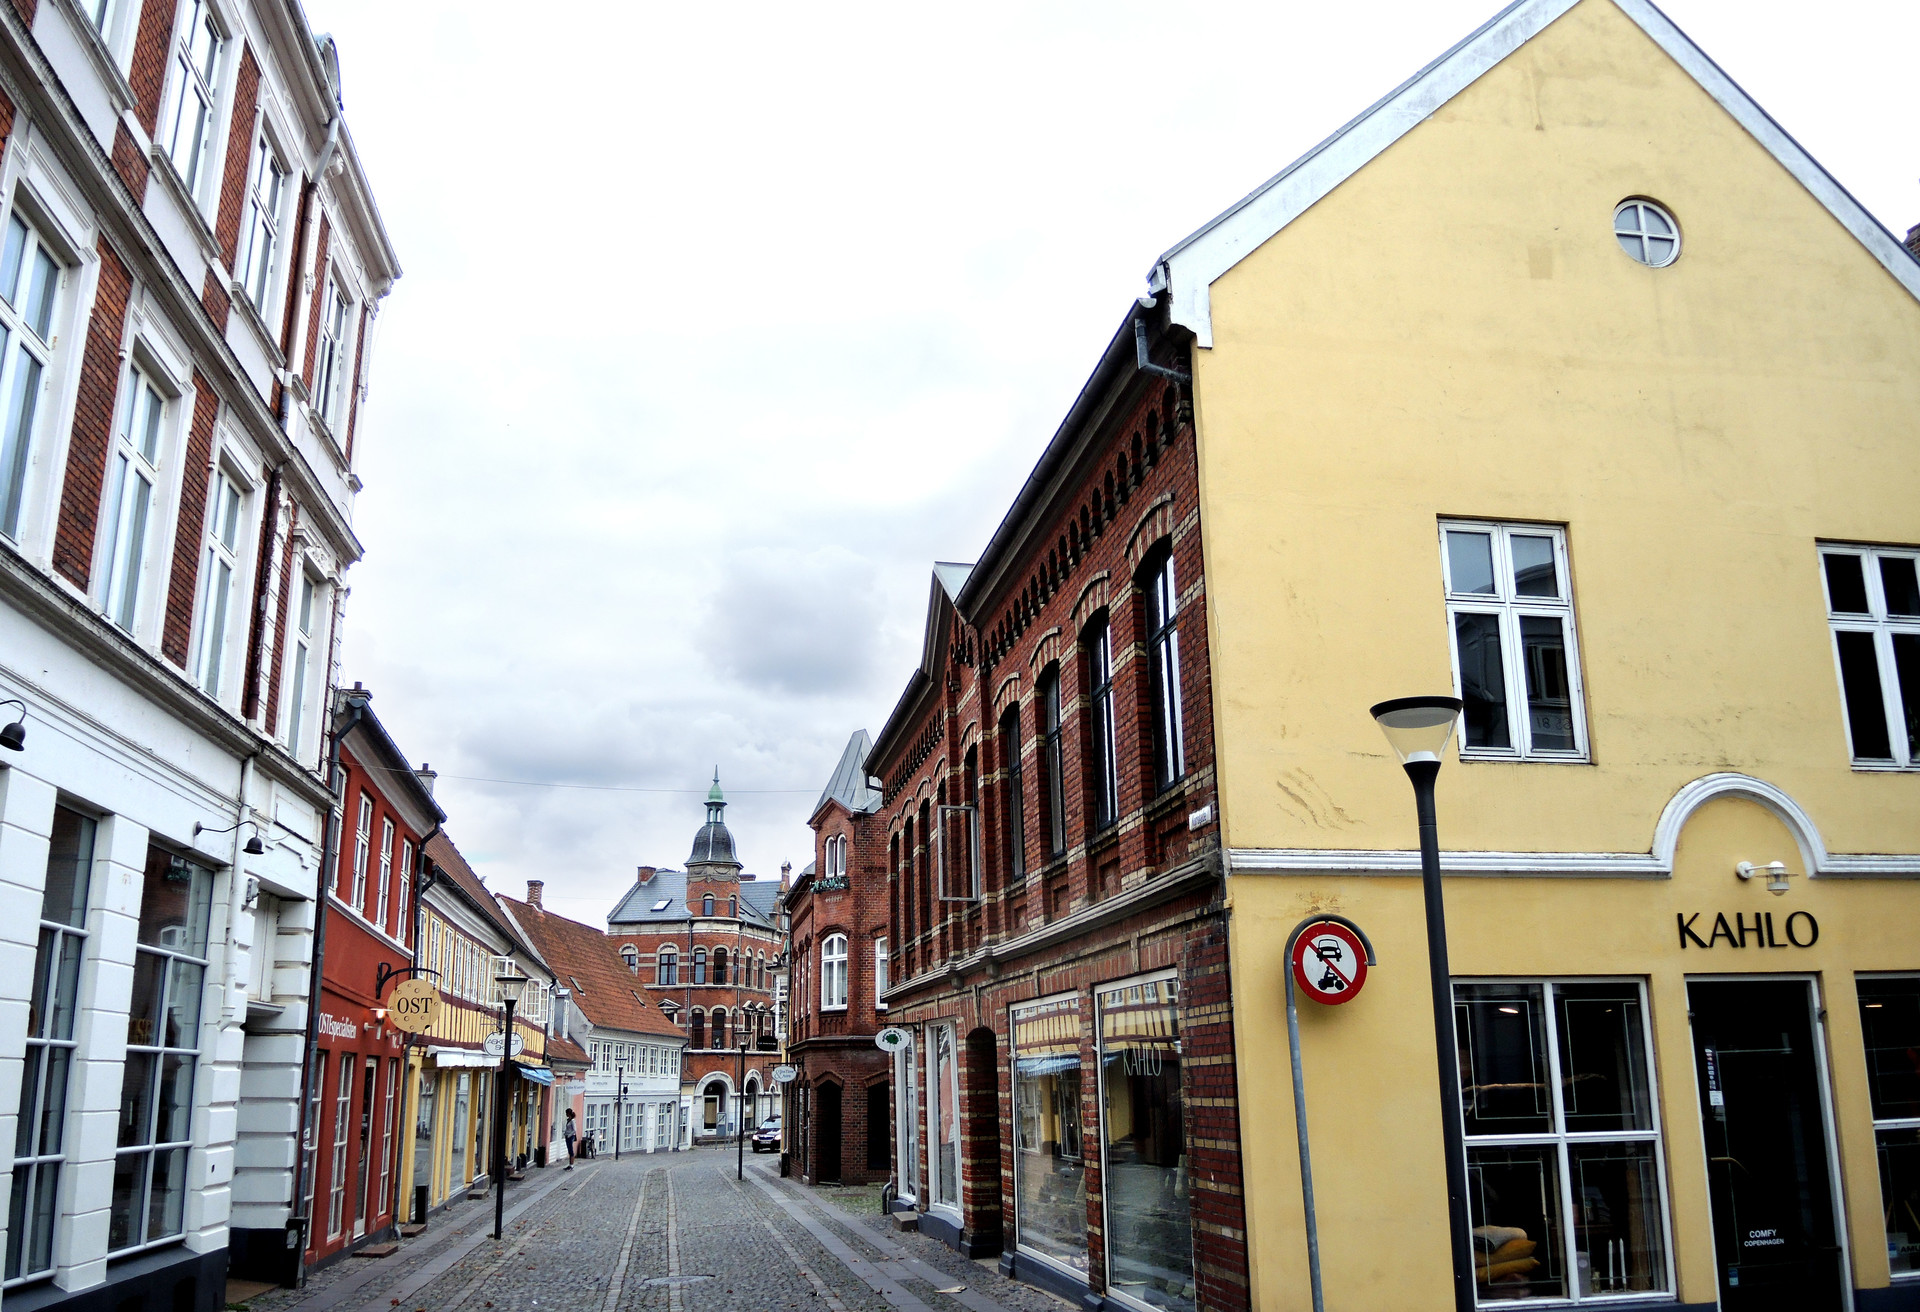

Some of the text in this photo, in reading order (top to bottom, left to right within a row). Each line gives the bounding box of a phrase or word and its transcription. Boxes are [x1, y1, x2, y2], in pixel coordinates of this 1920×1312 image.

[1677, 911, 1819, 949] KAHLO
[397, 997, 433, 1014] OST
[1123, 1043, 1162, 1077] KAHLO
[1743, 1238, 1785, 1247] COPENHAGEN
[1749, 1229, 1777, 1239] COMFY
